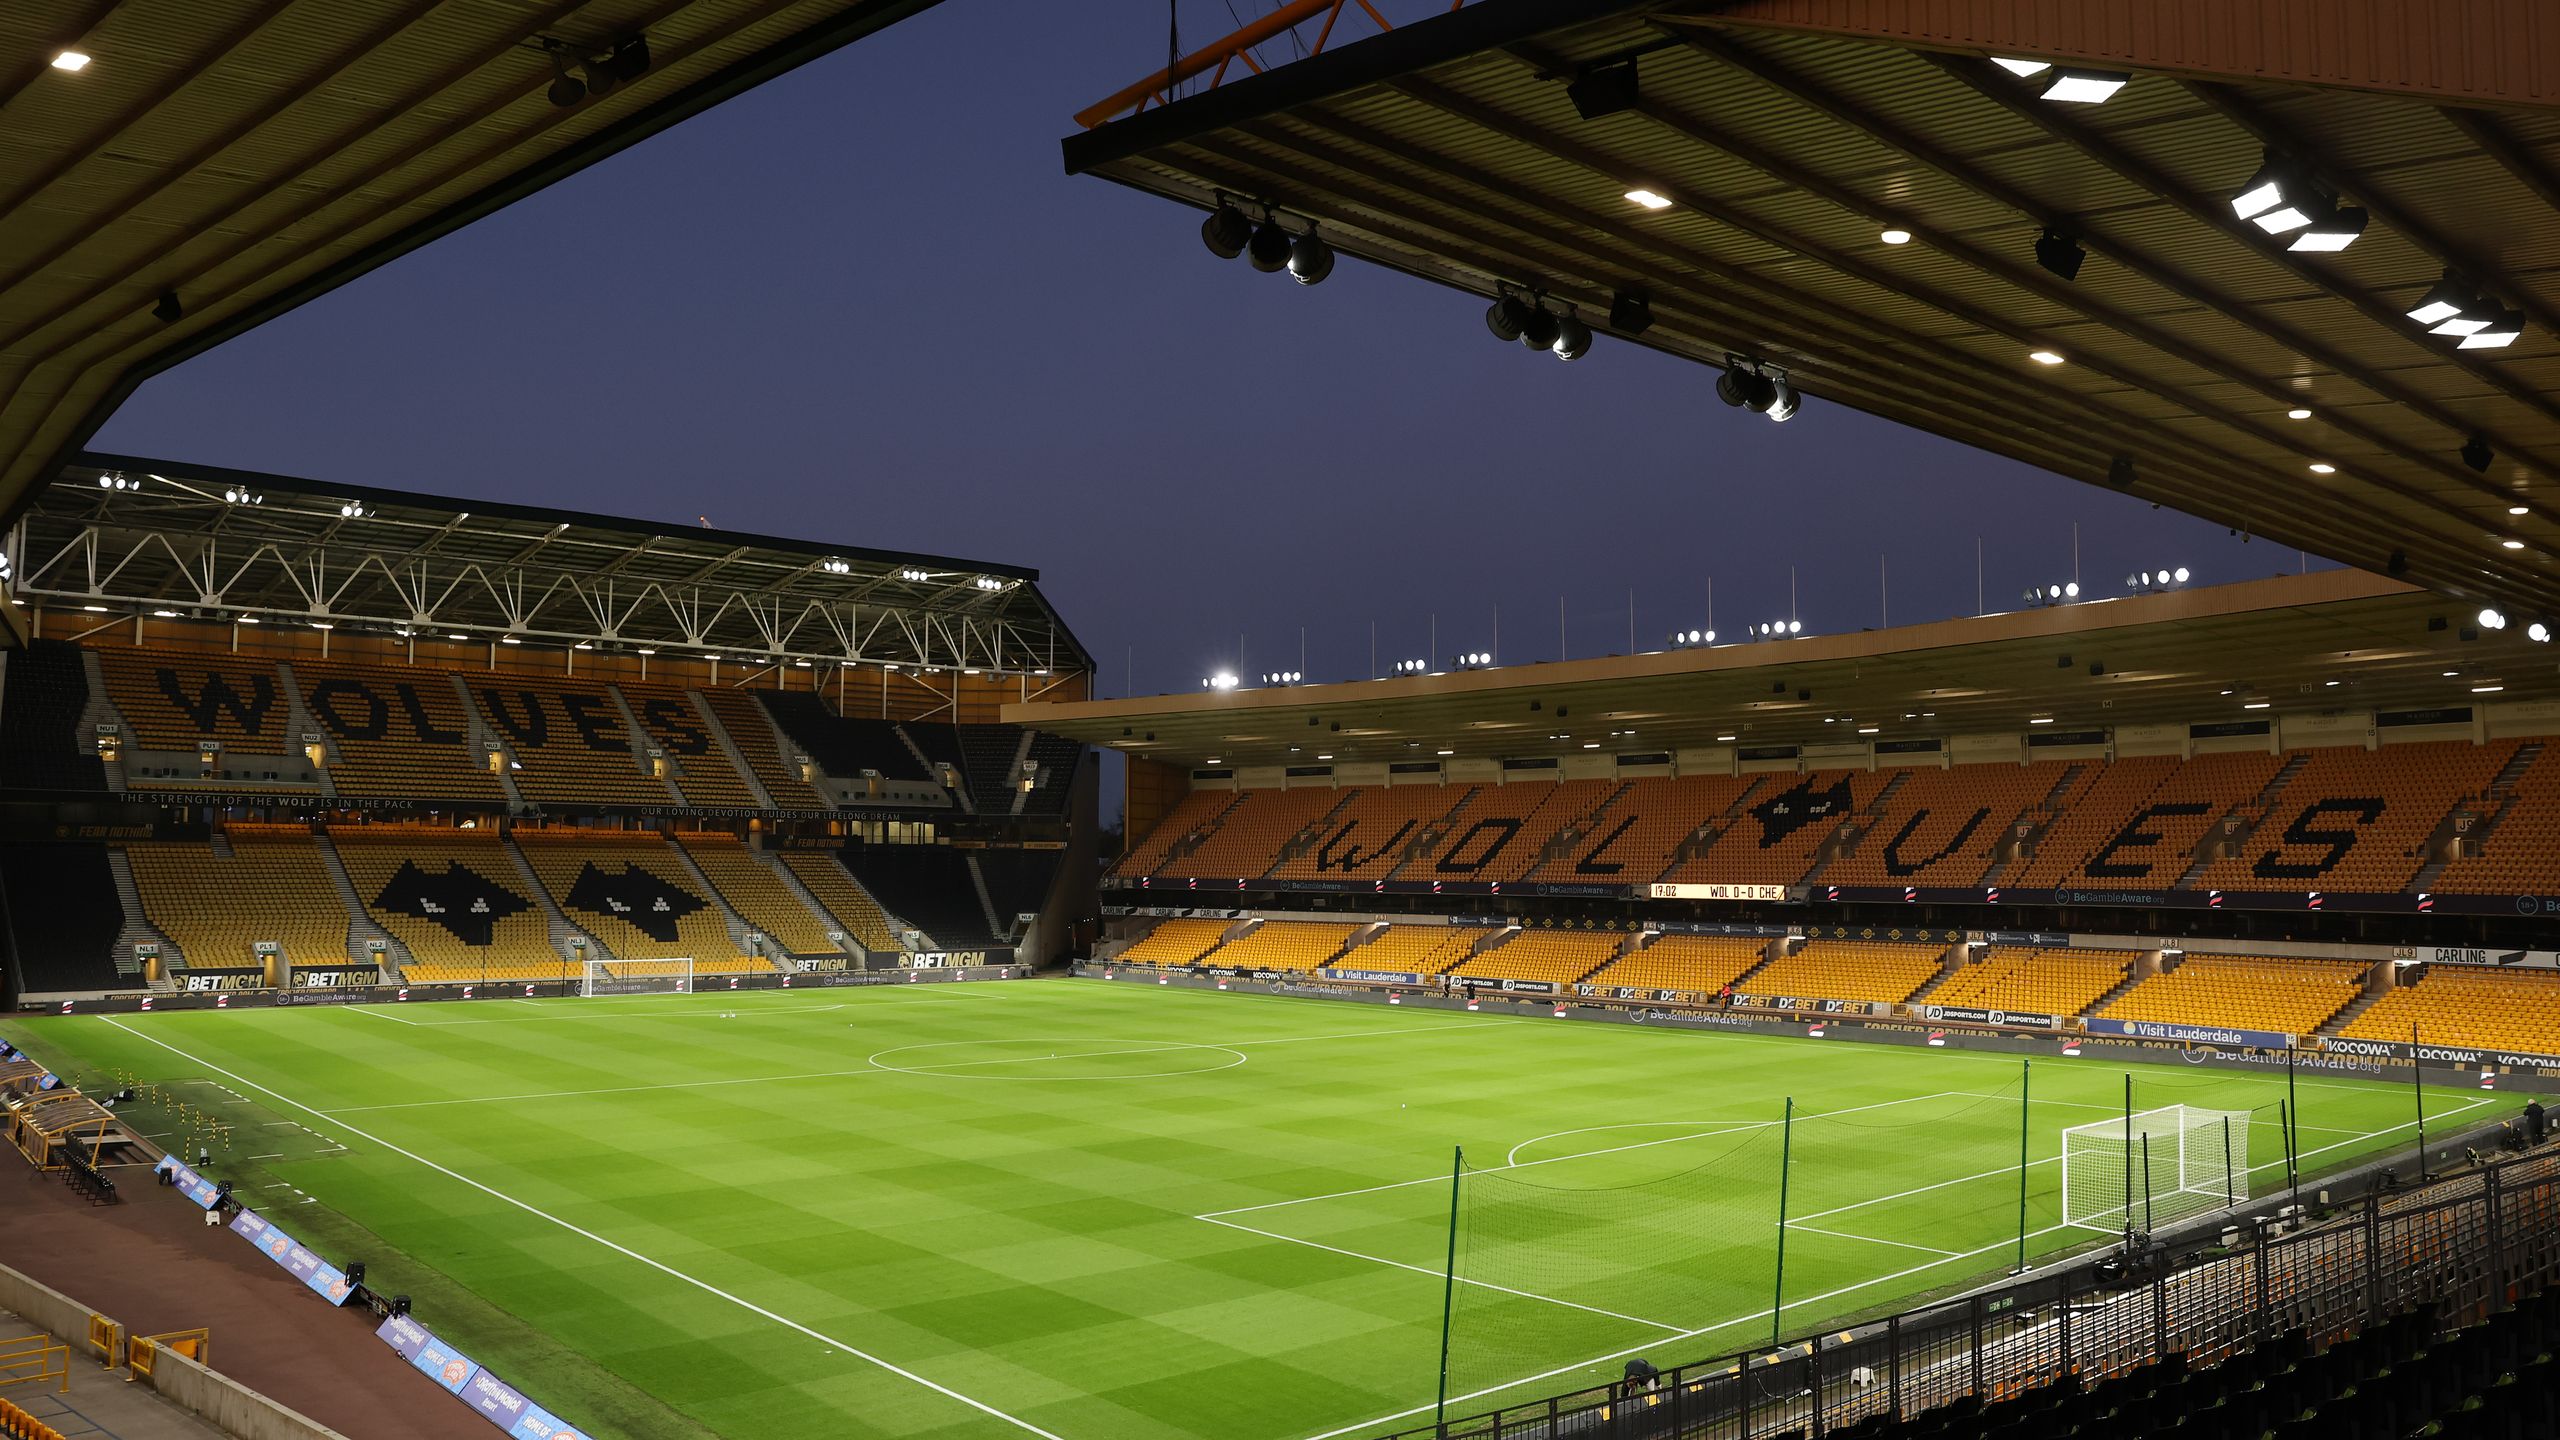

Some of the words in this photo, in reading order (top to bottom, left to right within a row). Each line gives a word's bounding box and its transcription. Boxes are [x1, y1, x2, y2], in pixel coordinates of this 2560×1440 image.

[155, 667, 709, 755] WOLVES
[119, 793, 145, 803] THE
[151, 794, 220, 805] STRENGTH
[226, 795, 242, 805] OF
[249, 796, 272, 806] THE
[278, 797, 315, 808] WOLF
[321, 798, 332, 808] IS
[338, 799, 352, 808] IN
[357, 799, 379, 809] THE
[385, 799, 414, 809] PACK
[641, 807, 662, 815] OUR
[666, 807, 704, 817] LOVING
[708, 808, 758, 818] DEVOTION
[762, 809, 797, 819] GUIDES
[801, 811, 820, 820] OUR
[824, 812, 867, 820] LIFELONG
[871, 812, 900, 821] DREAM
[798, 838, 816, 848] FEAR
[816, 838, 845, 848] NOTHING
[1655, 885, 1677, 897] 17:02
[1710, 886, 1729, 898] WOL
[1734, 886, 1754, 898] 0-0
[1759, 887, 1777, 899] CHE
[2074, 892, 2165, 905] BeGambleAware.org
[1102, 906, 1124, 914] CARLING
[1155, 907, 1176, 916] CARLING
[1200, 909, 1221, 918] CARLING
[2162, 939, 2176, 948] JL8
[2396, 948, 2413, 957] JL9
[2435, 948, 2486, 963] CARLING
[796, 959, 847, 972] BETMGM
[913, 951, 986, 968] BETMGM
[306, 971, 379, 987] BETMGM
[1345, 970, 1362, 980] Visit
[1363, 972, 1407, 983] Lauderdale
[1580, 985, 1616, 998] DEBET
[1619, 987, 1656, 1000] DEBET
[1733, 994, 1773, 1008] DEBET
[1778, 997, 1820, 1011] DEBET
[1825, 1000, 1869, 1014] DEBET
[1943, 1010, 1986, 1020] JDSPORTS.COM
[2004, 1015, 2050, 1026] JDSPORTS.COM
[2138, 1023, 2166, 1037] Visit
[2168, 1025, 2242, 1044] Lauderdale
[2328, 1039, 2397, 1057] KOCOWA+
